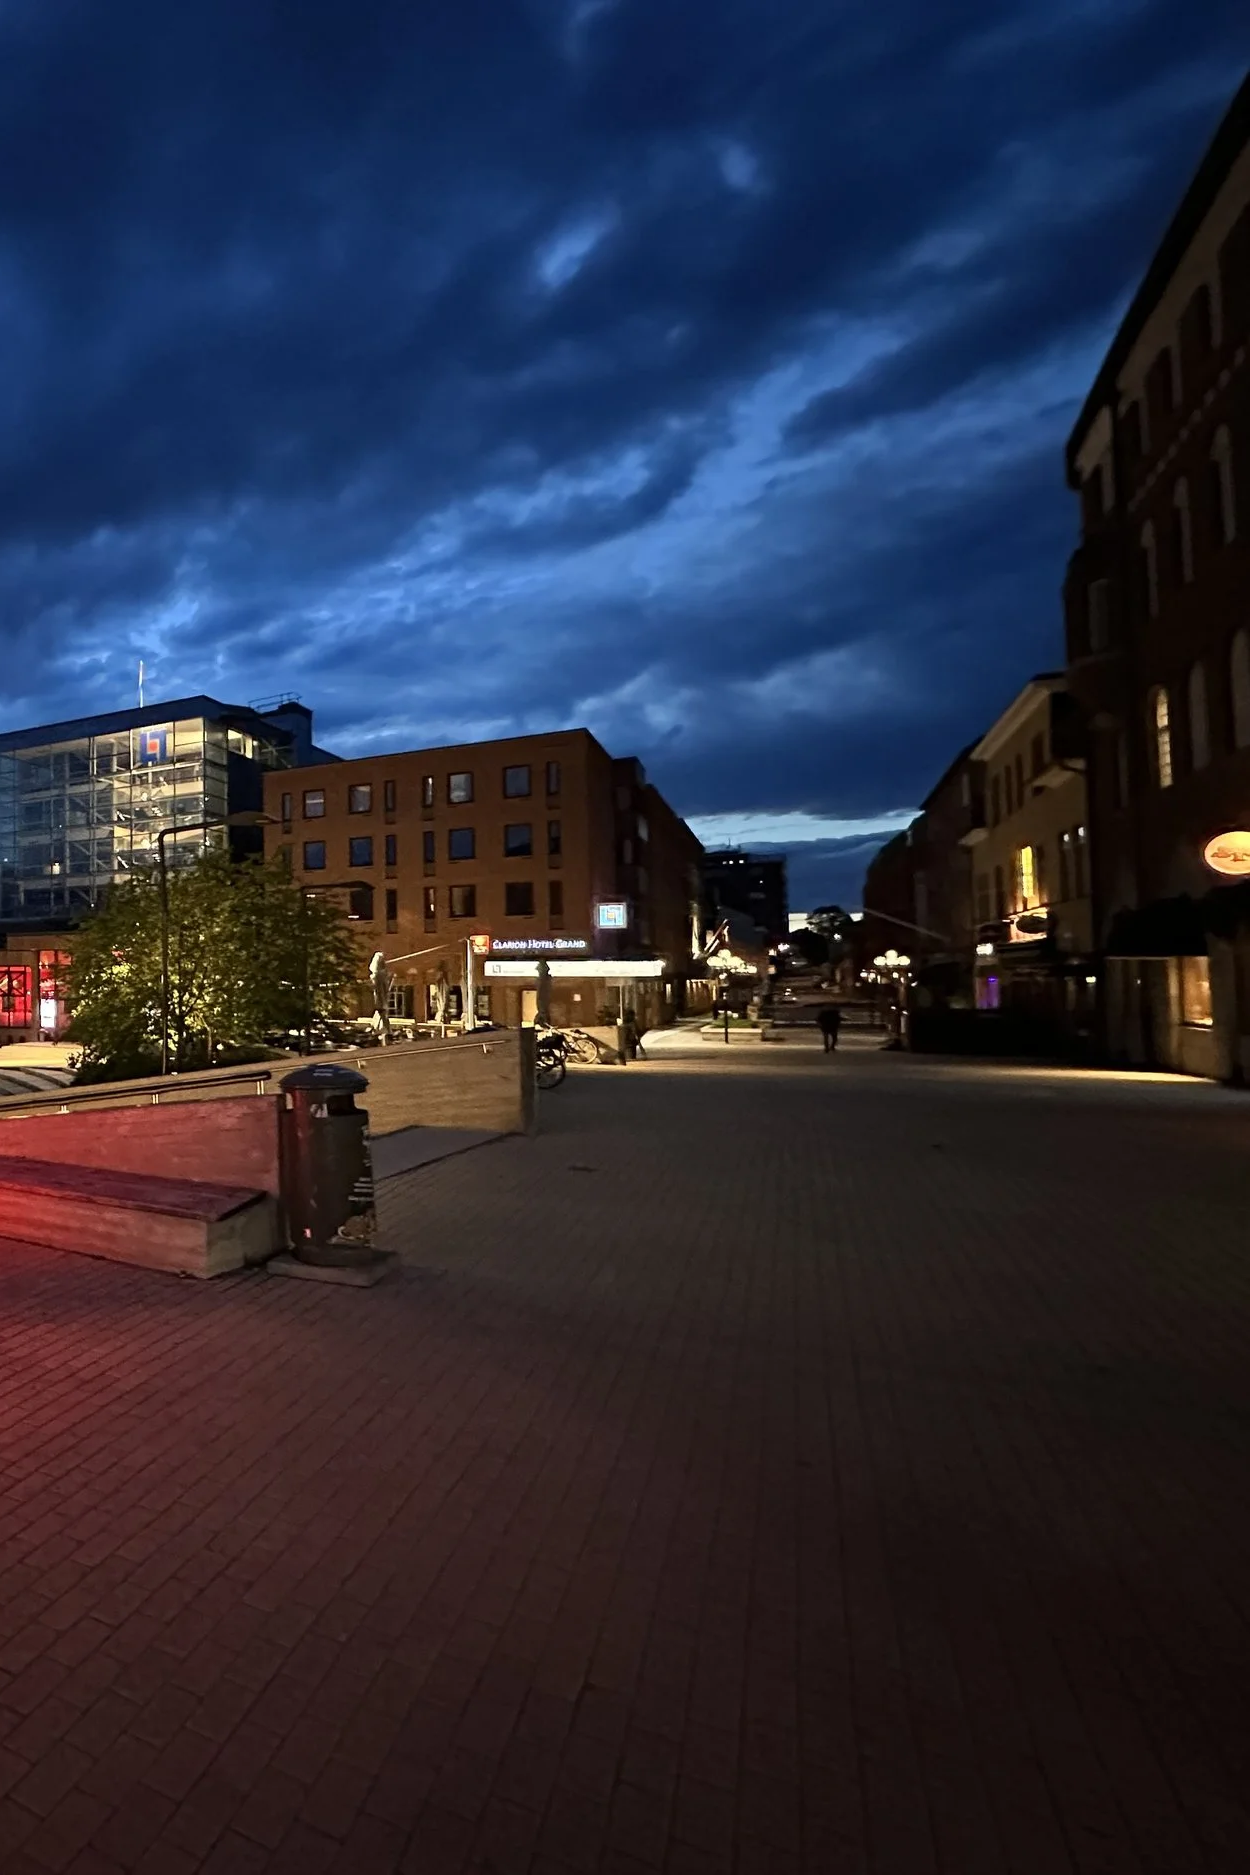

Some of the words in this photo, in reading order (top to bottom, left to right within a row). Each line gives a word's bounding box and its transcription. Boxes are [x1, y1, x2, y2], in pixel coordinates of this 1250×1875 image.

[492, 939, 527, 949] CLARION
[528, 938, 554, 949] HOTEL
[555, 938, 586, 949] GRAND
